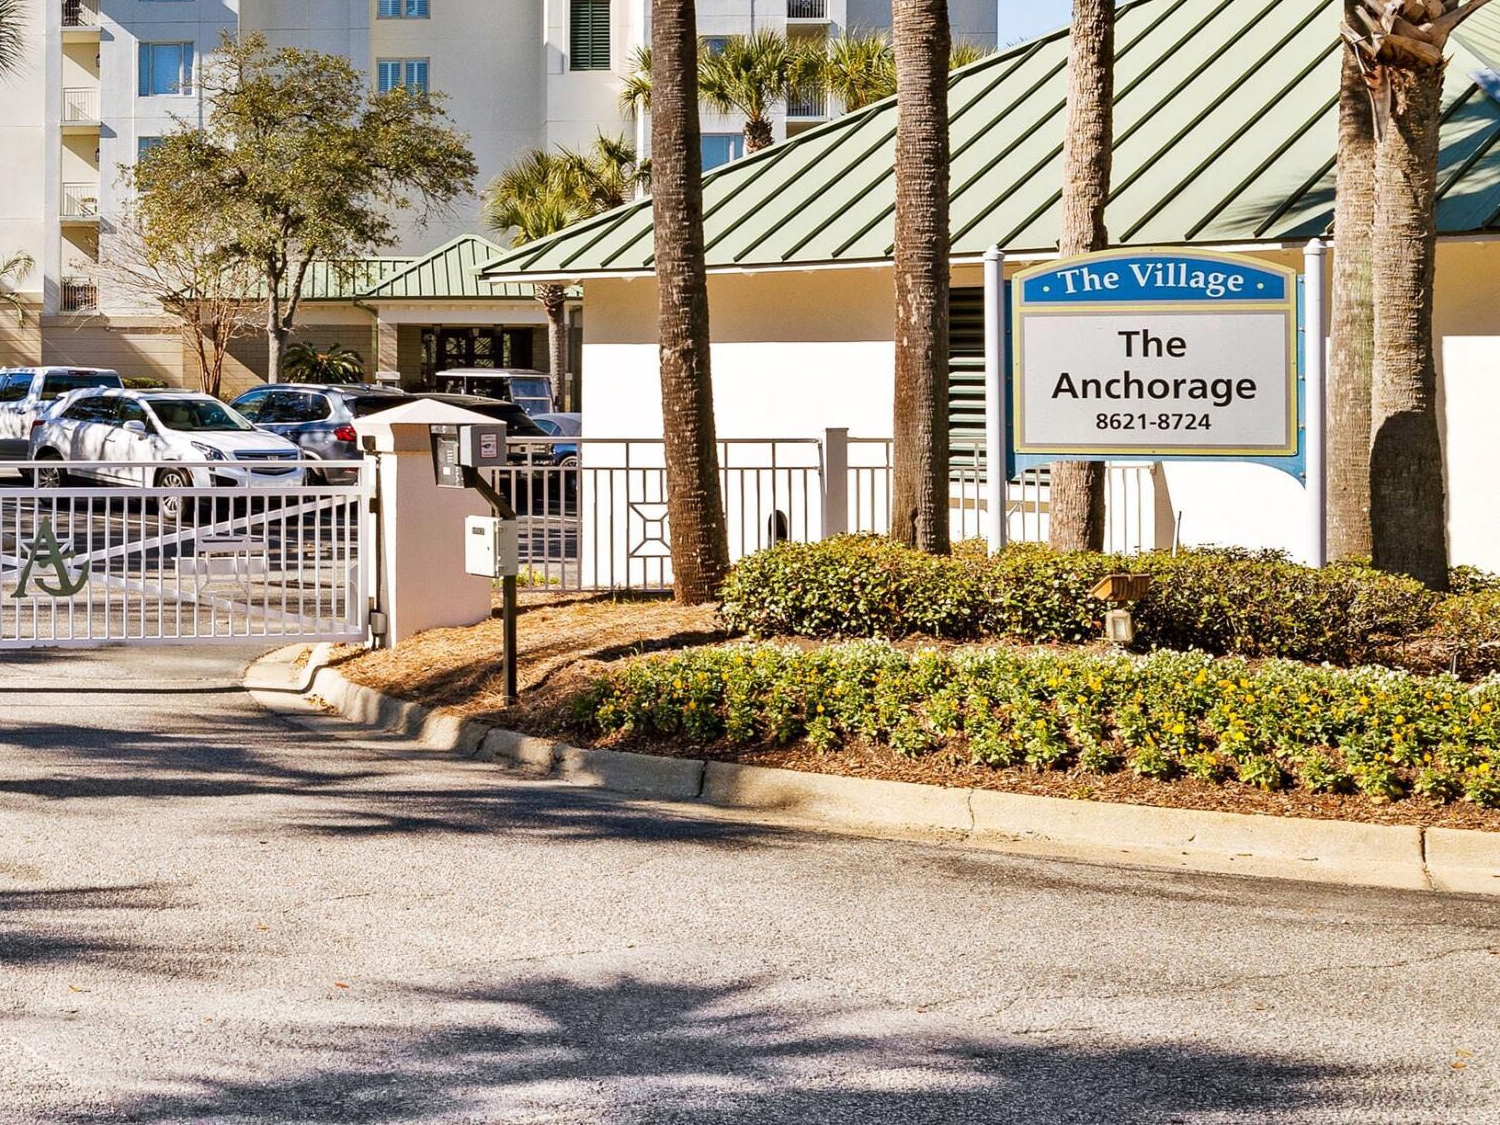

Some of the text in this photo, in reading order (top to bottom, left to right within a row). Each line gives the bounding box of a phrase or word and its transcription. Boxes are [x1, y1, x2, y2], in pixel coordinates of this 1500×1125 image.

[1057, 263, 1244, 298] The Village
[1117, 328, 1187, 358] The
[1051, 370, 1257, 407] Anchorage
[1096, 412, 1212, 430] 8621-8724
